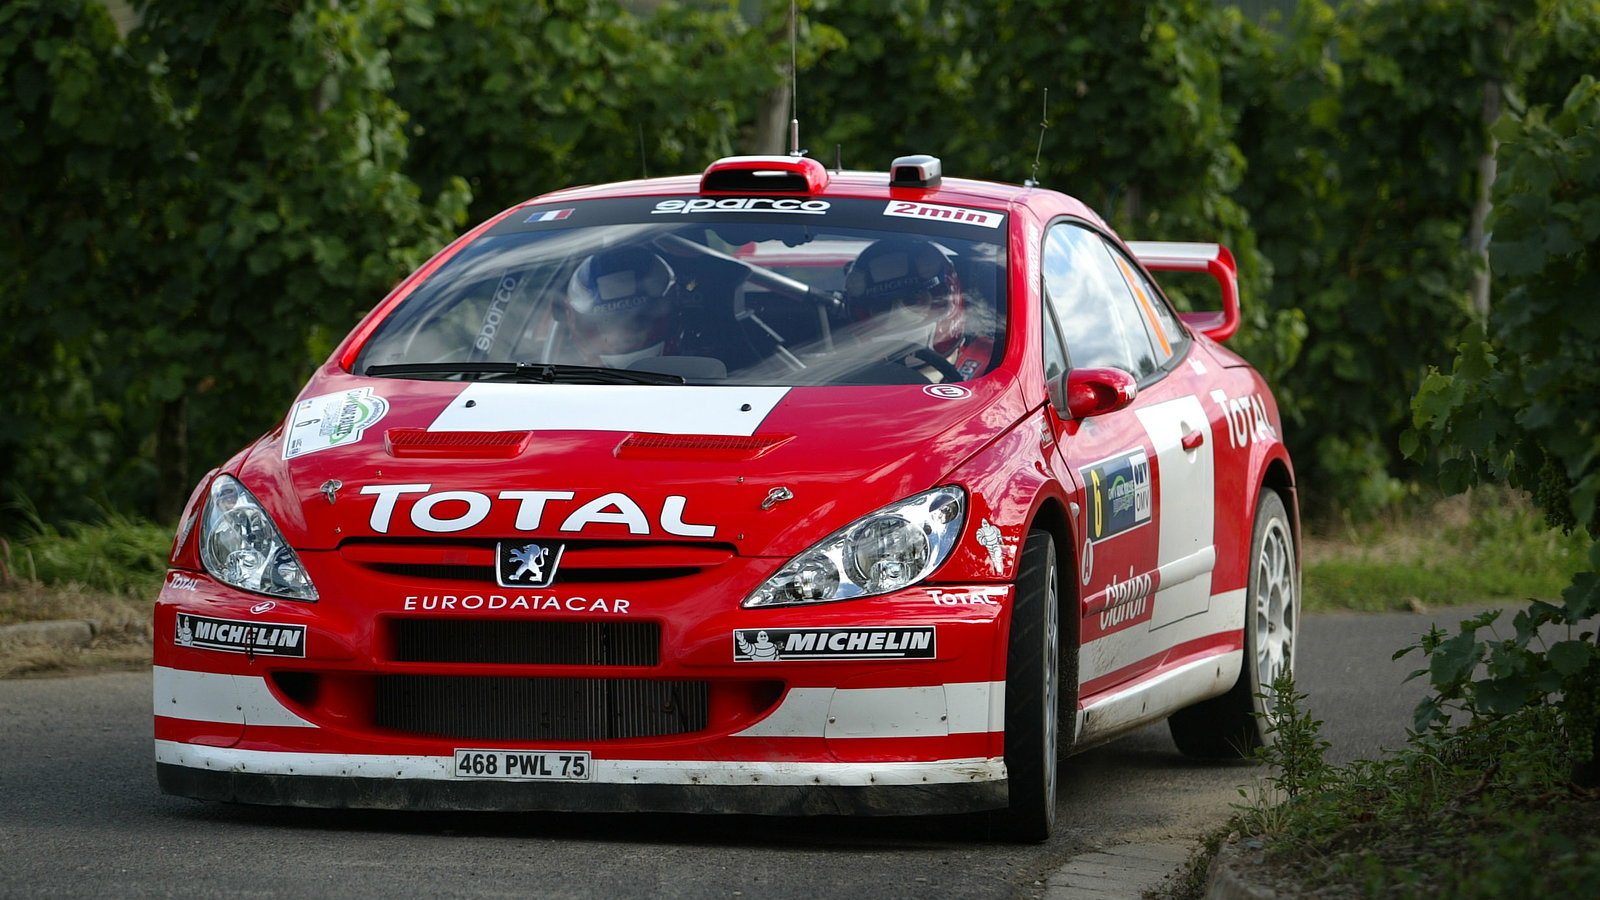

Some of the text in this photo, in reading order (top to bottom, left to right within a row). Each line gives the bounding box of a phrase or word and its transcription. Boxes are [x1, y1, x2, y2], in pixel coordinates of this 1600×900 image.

[655, 198, 831, 213] sparco
[893, 203, 988, 223] 2min
[476, 276, 517, 351] sparco
[1091, 469, 1102, 538] 6
[404, 594, 631, 614] EURODATACAR
[1100, 565, 1152, 630] clarion
[194, 621, 302, 648] MICHELIN
[784, 631, 932, 651] MICHELIN
[458, 753, 585, 777] 468 PWL 75
